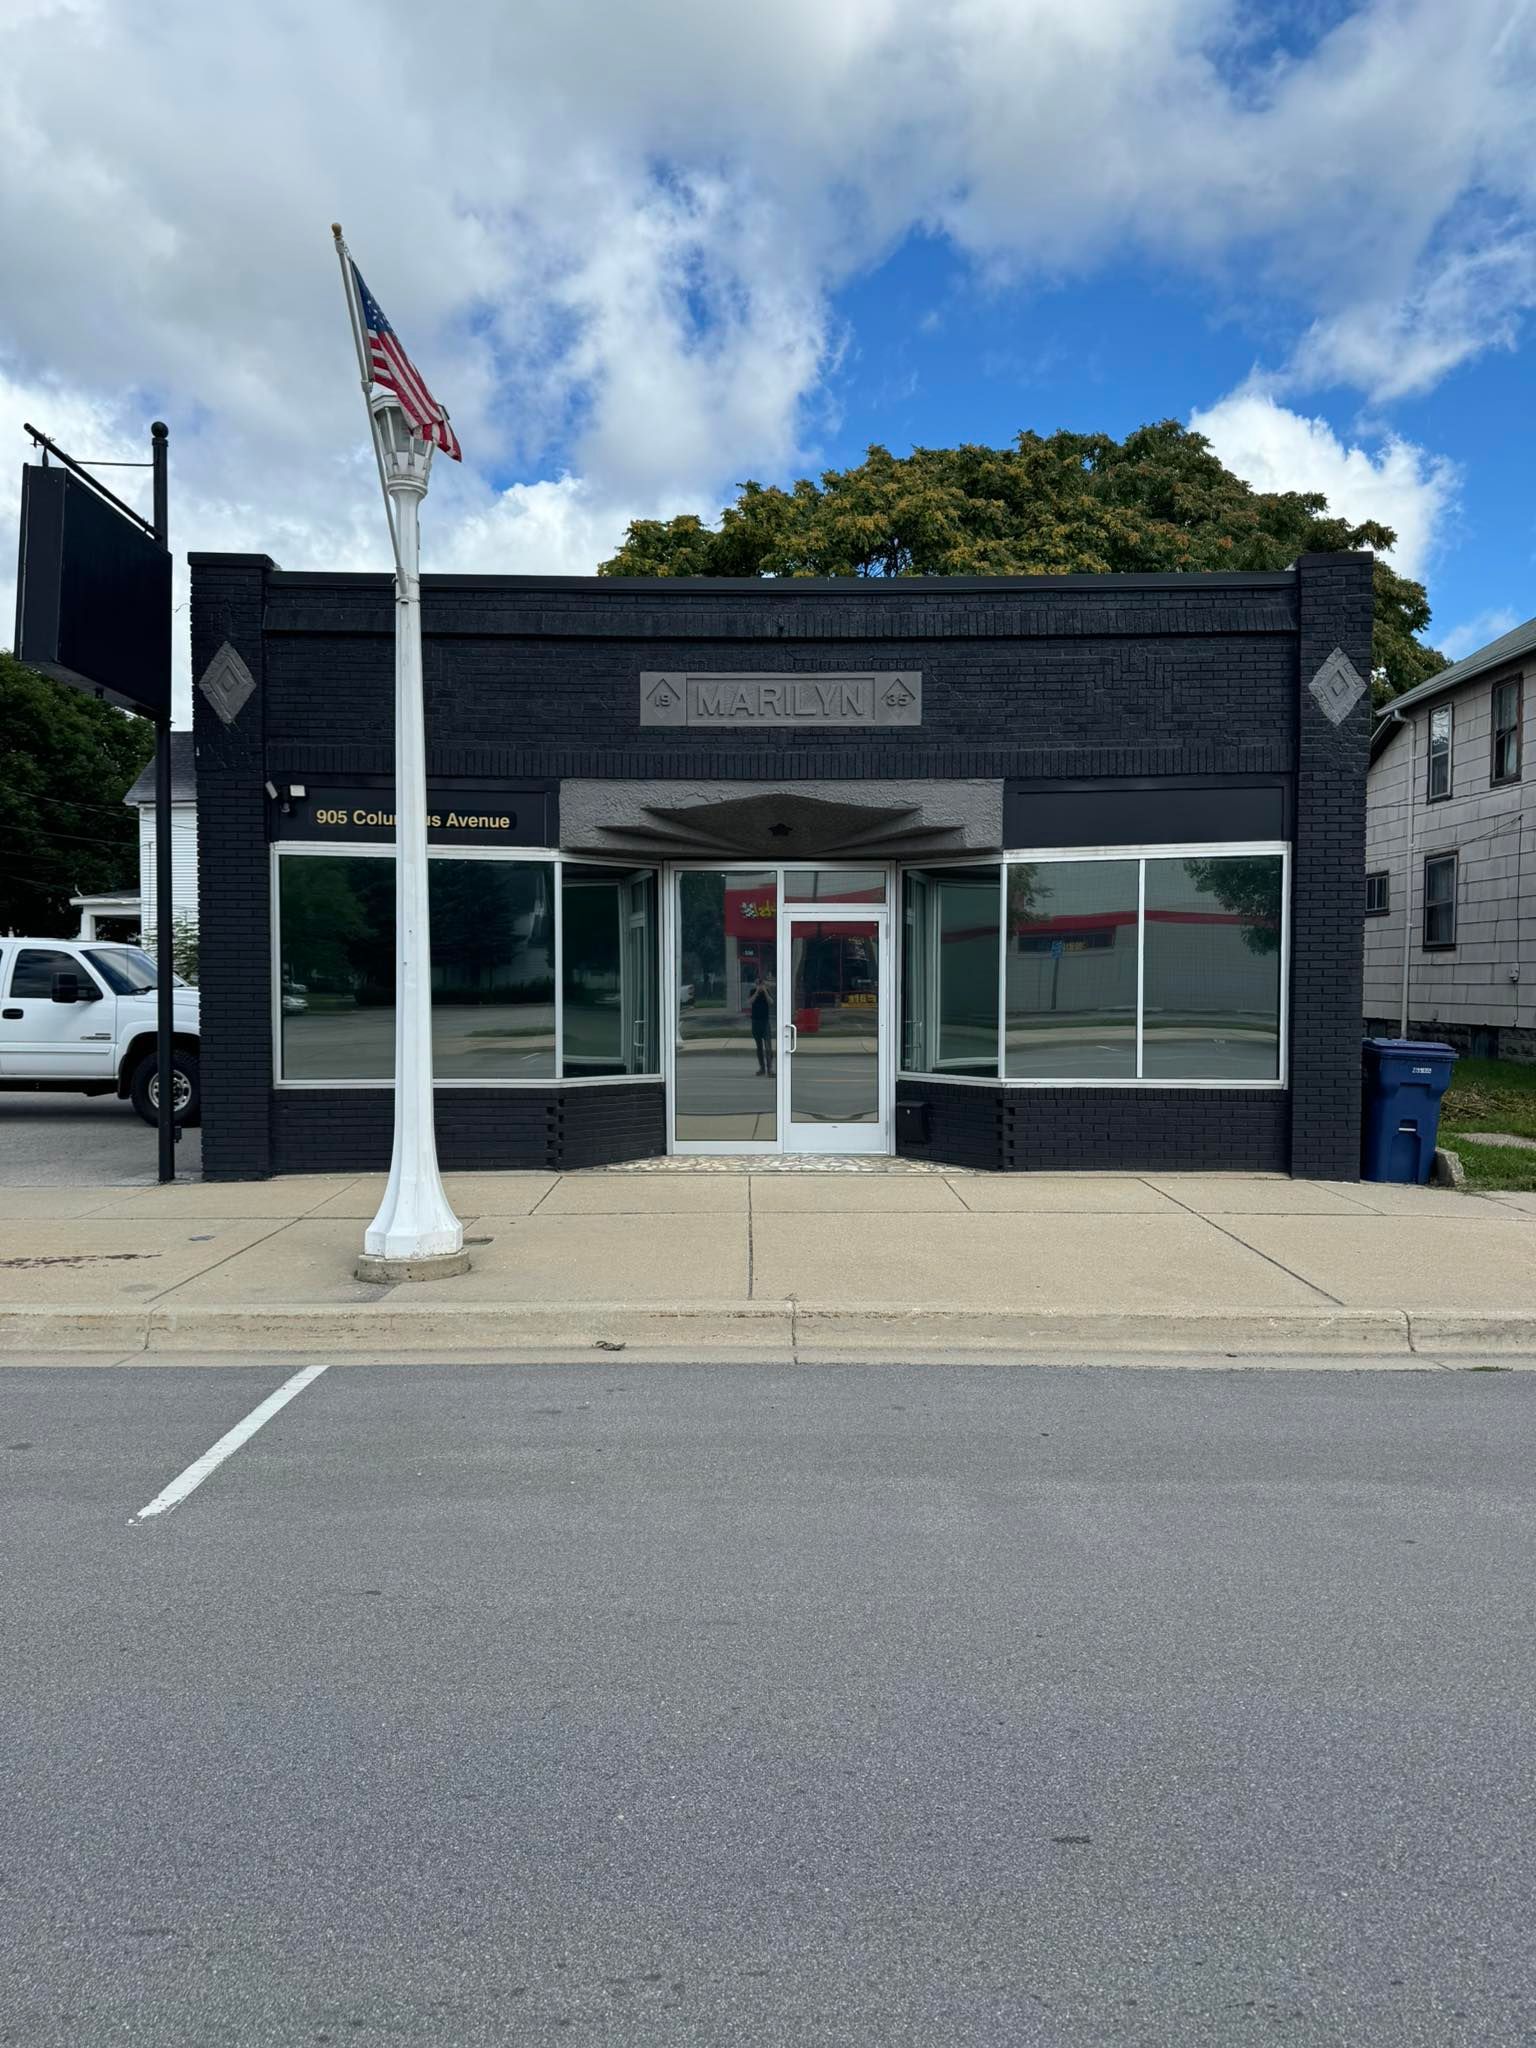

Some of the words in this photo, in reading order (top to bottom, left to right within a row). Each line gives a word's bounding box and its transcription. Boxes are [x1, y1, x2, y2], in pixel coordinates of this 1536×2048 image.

[696, 684, 865, 716] MARILYN
[886, 692, 910, 707] 35
[316, 809, 348, 824] 905
[353, 810, 441, 828] Colus
[446, 812, 510, 828] Avenue
